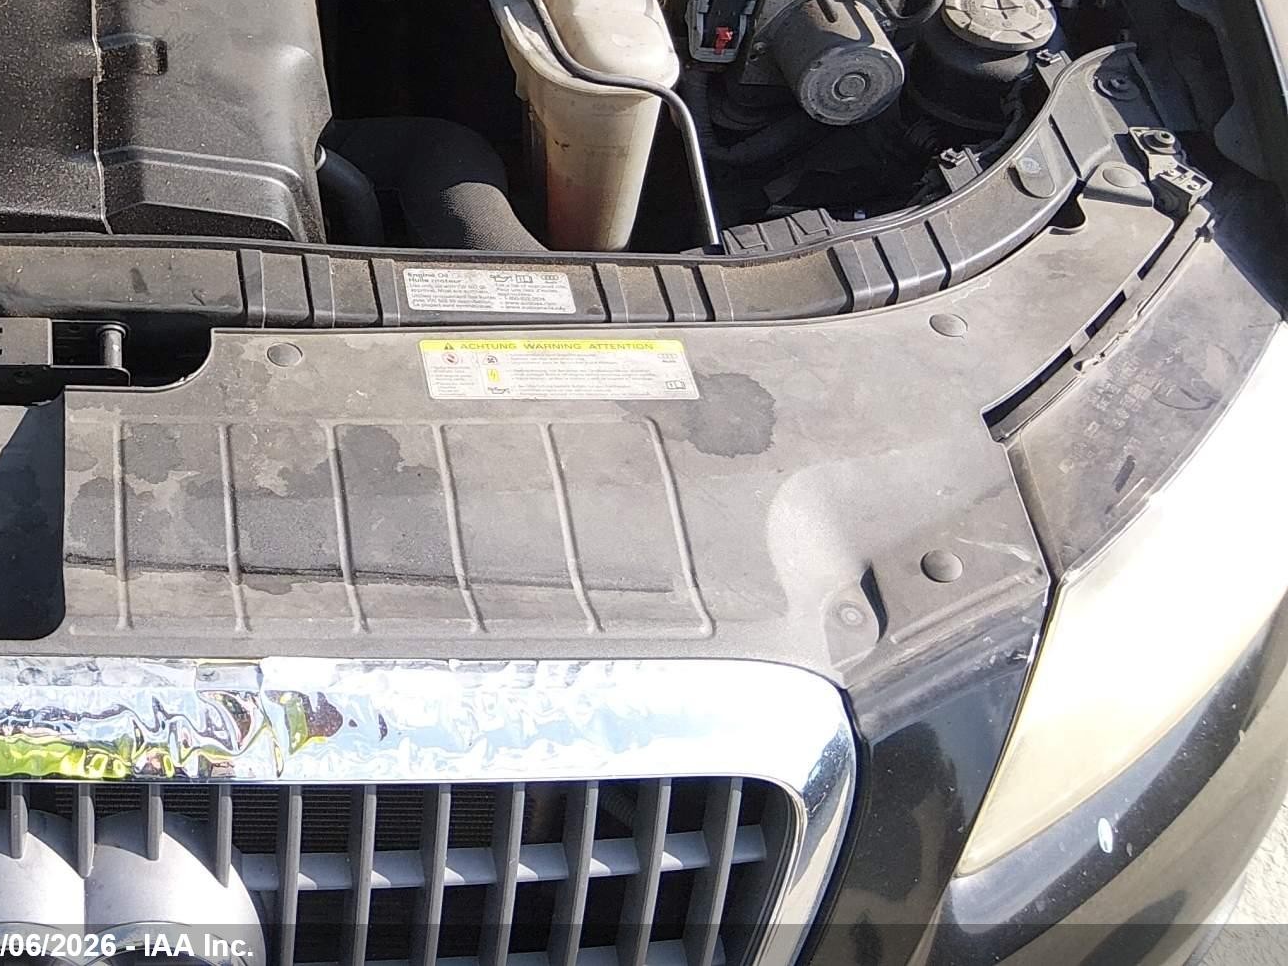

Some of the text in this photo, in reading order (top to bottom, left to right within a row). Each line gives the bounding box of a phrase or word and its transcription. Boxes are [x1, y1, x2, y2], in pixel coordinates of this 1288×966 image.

[460, 342, 654, 350] ACHTUNG WARNING ATTENTION
